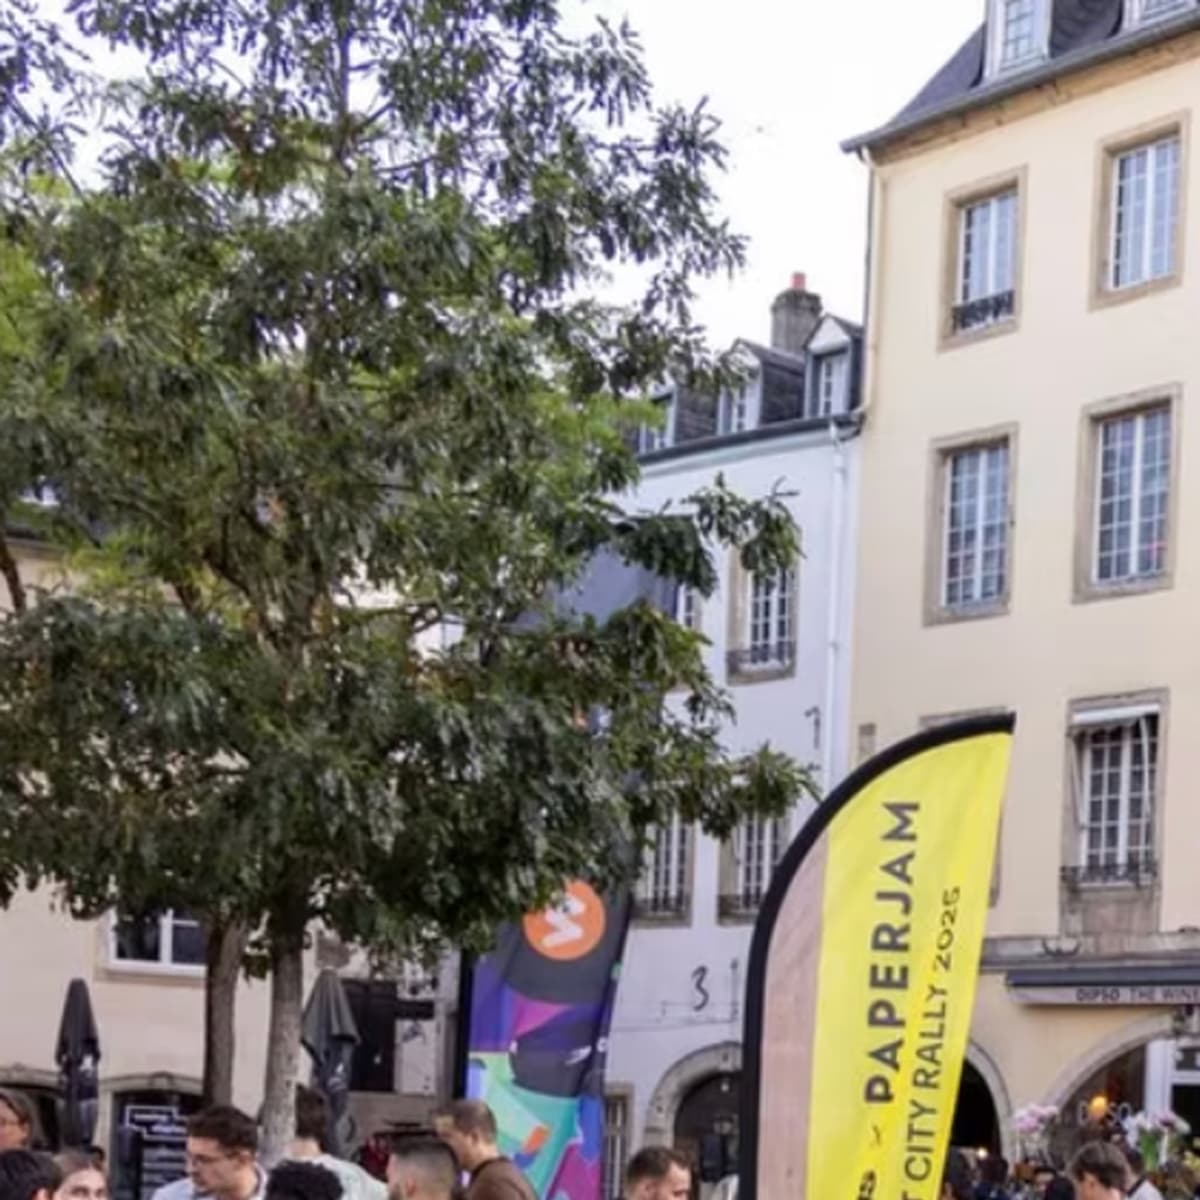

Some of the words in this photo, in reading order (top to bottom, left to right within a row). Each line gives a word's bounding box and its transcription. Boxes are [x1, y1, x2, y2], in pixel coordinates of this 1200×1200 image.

[864, 801, 920, 1103] PAPERJAM
[932, 886, 961, 971] 2025
[912, 984, 948, 1090] RALLY
[904, 1099, 939, 1182] CITY
